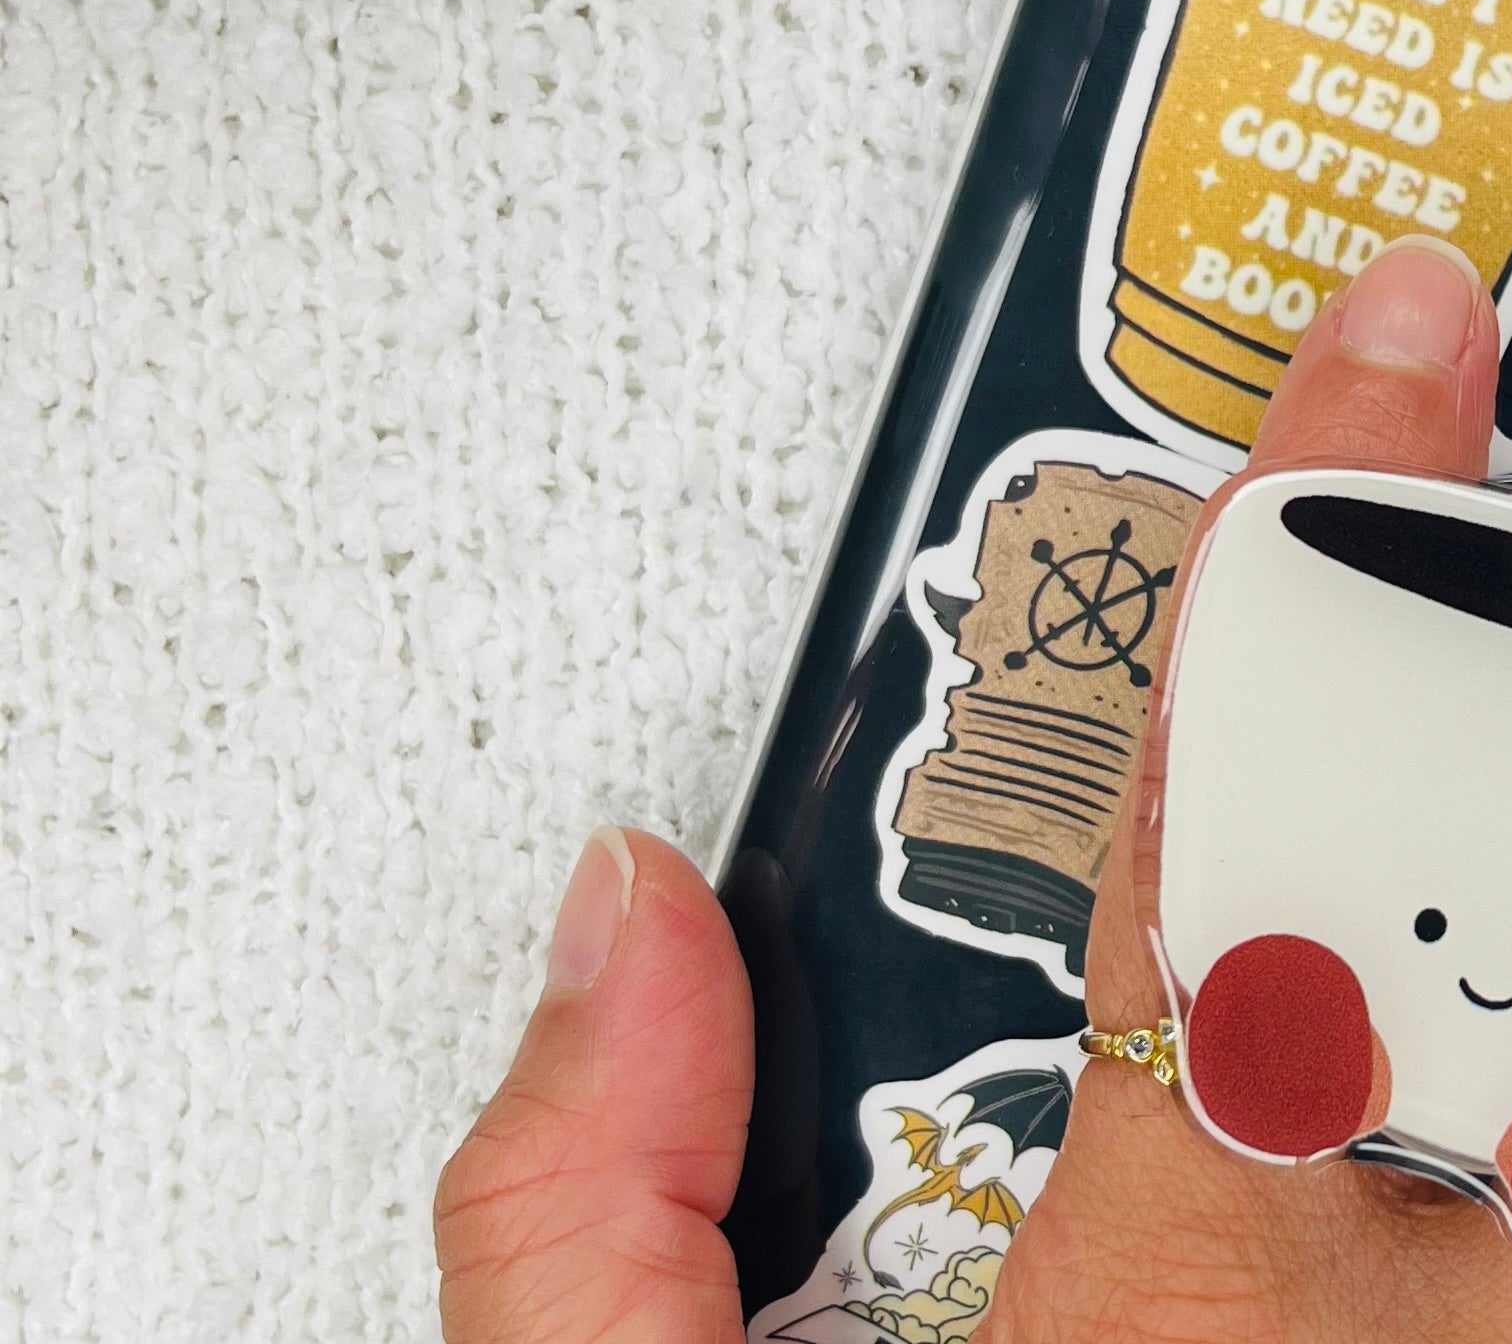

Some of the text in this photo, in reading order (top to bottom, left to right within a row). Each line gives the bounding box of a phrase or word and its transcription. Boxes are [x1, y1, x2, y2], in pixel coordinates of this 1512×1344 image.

[1288, 54, 1443, 148] ICED
[1219, 105, 1467, 232] COFFEE
[1240, 192, 1386, 277] AND
[1180, 245, 1333, 333] BOO
